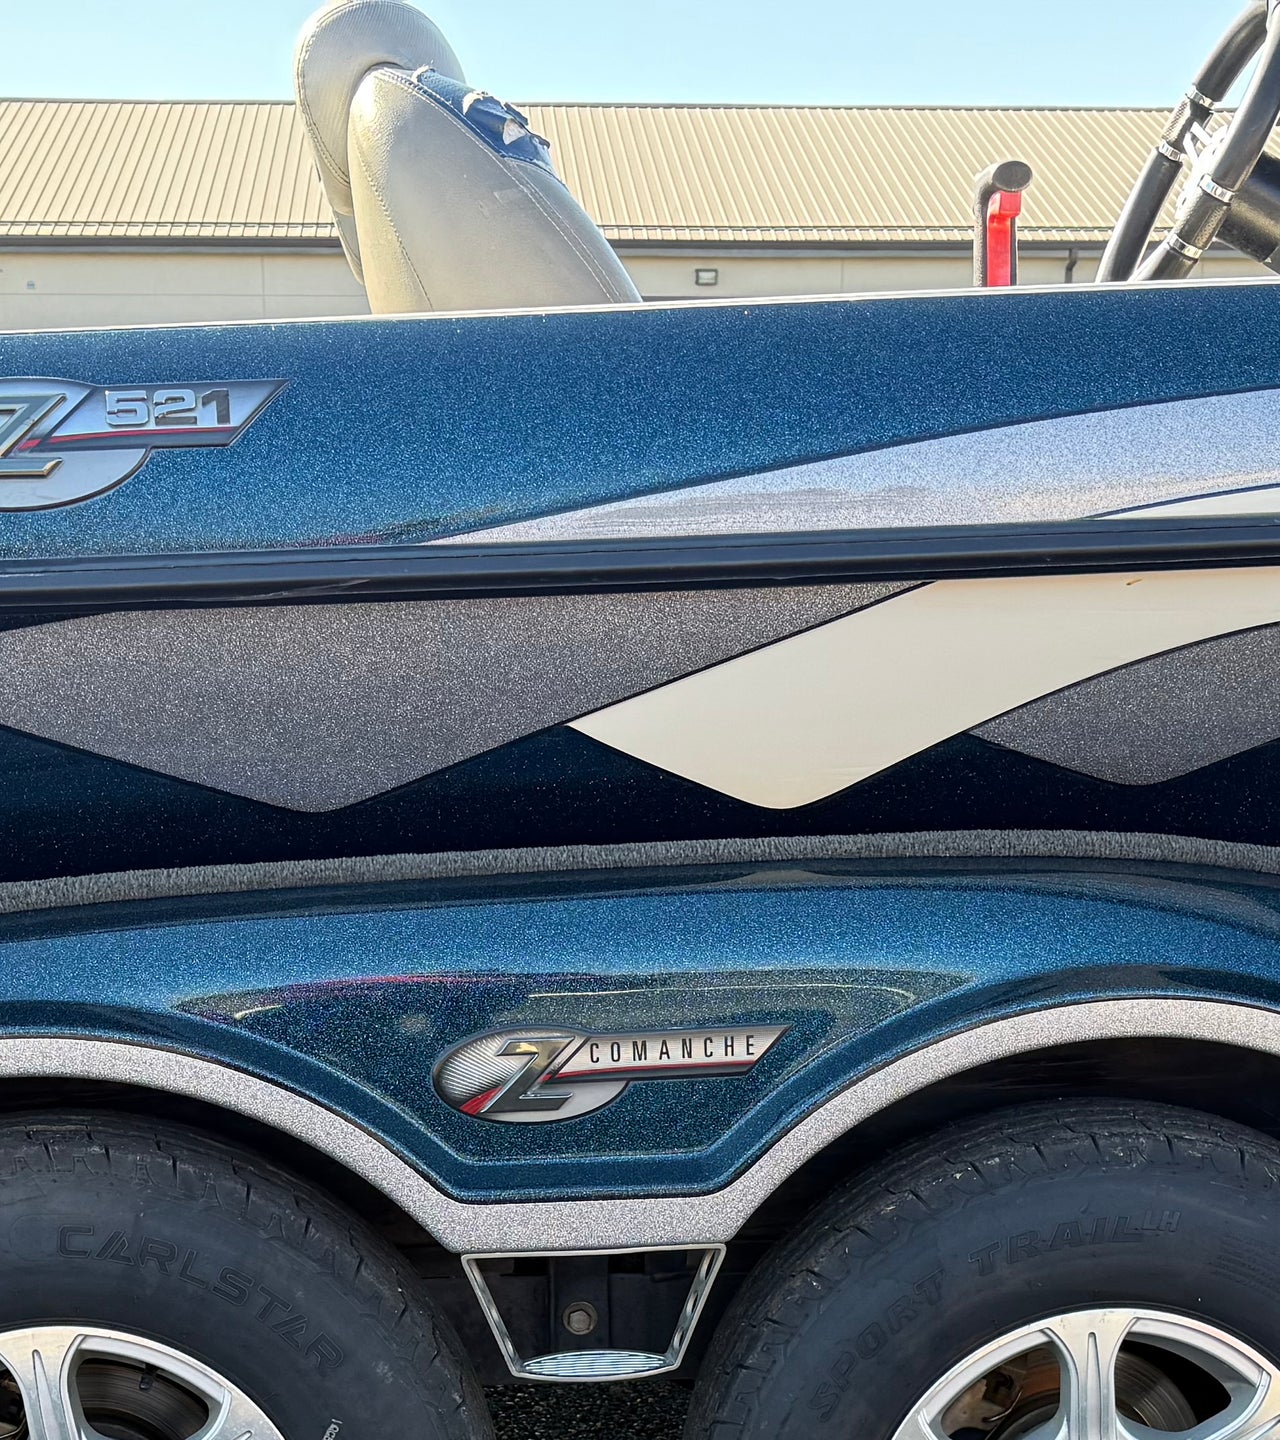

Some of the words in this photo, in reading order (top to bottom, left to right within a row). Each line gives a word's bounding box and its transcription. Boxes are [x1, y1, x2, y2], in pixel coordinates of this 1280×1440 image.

[103, 387, 234, 430] 521
[481, 1036, 577, 1114] Z
[590, 1034, 756, 1064] COMANCHE
[55, 1222, 347, 1373] CARLSTAR
[810, 1269, 945, 1423] SPORT
[966, 1213, 1146, 1275] TRAIL
